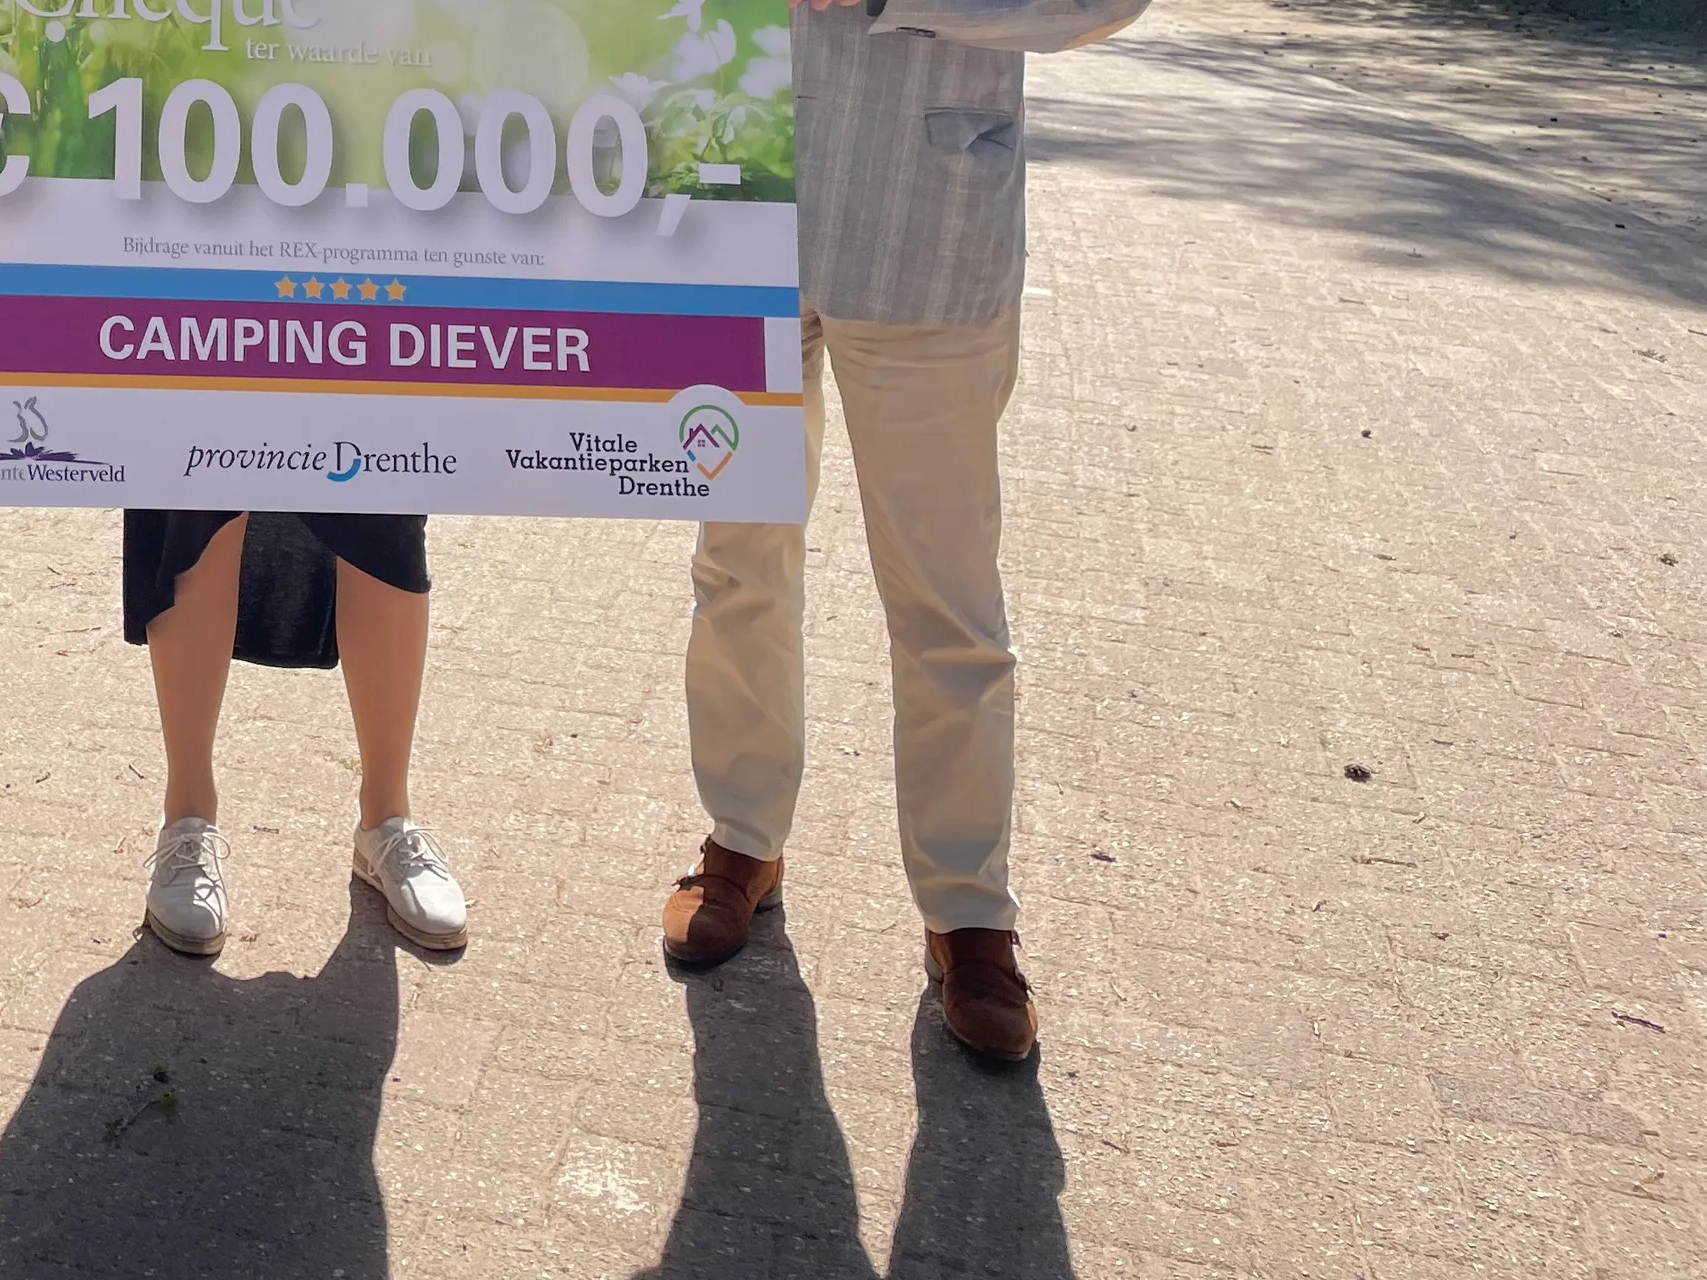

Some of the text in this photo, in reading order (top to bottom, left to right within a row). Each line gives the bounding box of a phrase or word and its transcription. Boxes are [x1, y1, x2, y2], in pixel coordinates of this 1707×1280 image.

[245, 36, 432, 67] ter waarde van
[87, 77, 742, 238] 100.000,-
[123, 236, 545, 268] Bijdrage vanuit het REX-programma ten gunste van:
[99, 315, 592, 372] CAMPING DIEVER
[569, 432, 638, 453] Vitale
[183, 441, 458, 482] provincie Drenthe
[505, 449, 690, 476] Vakantieparken
[618, 475, 710, 498] Drenthe
